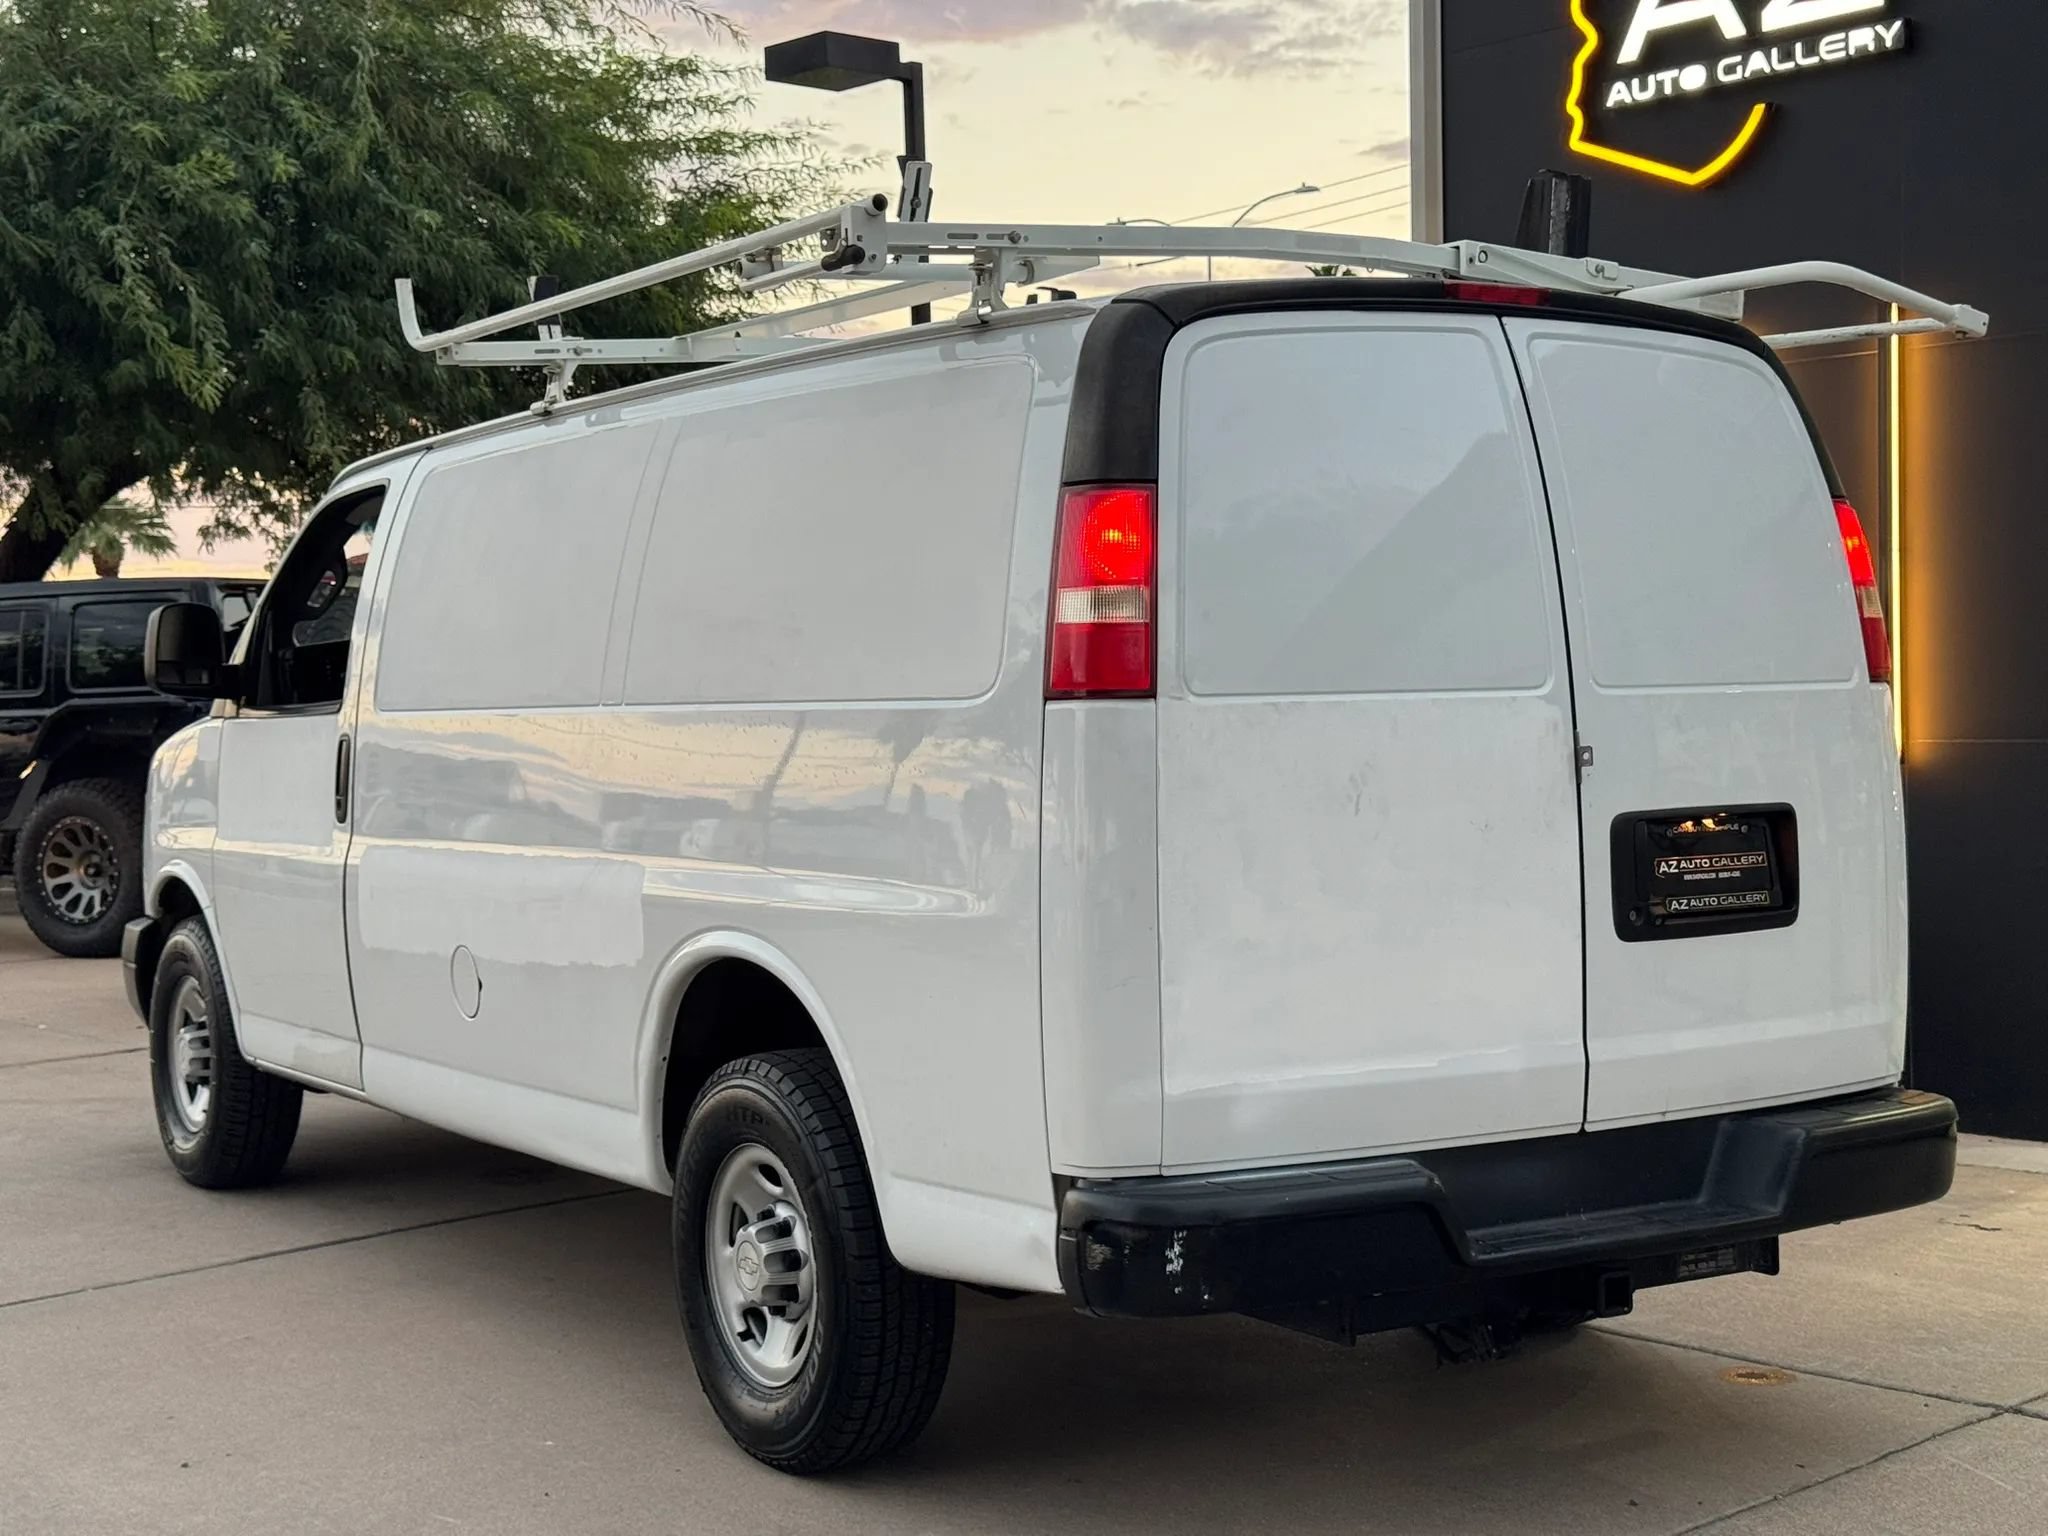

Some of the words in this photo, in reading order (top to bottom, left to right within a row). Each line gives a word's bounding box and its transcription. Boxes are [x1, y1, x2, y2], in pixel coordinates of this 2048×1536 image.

[1606, 64, 1707, 108] AUTO
[1717, 20, 1903, 82] GALLERY
[1659, 860, 1679, 874] AZ
[1680, 859, 1710, 869] AUTO
[1712, 855, 1763, 867] GALLERY
[1671, 899, 1689, 911] AZ
[1690, 897, 1718, 907] AUTO
[1720, 893, 1766, 905] GALLERY
